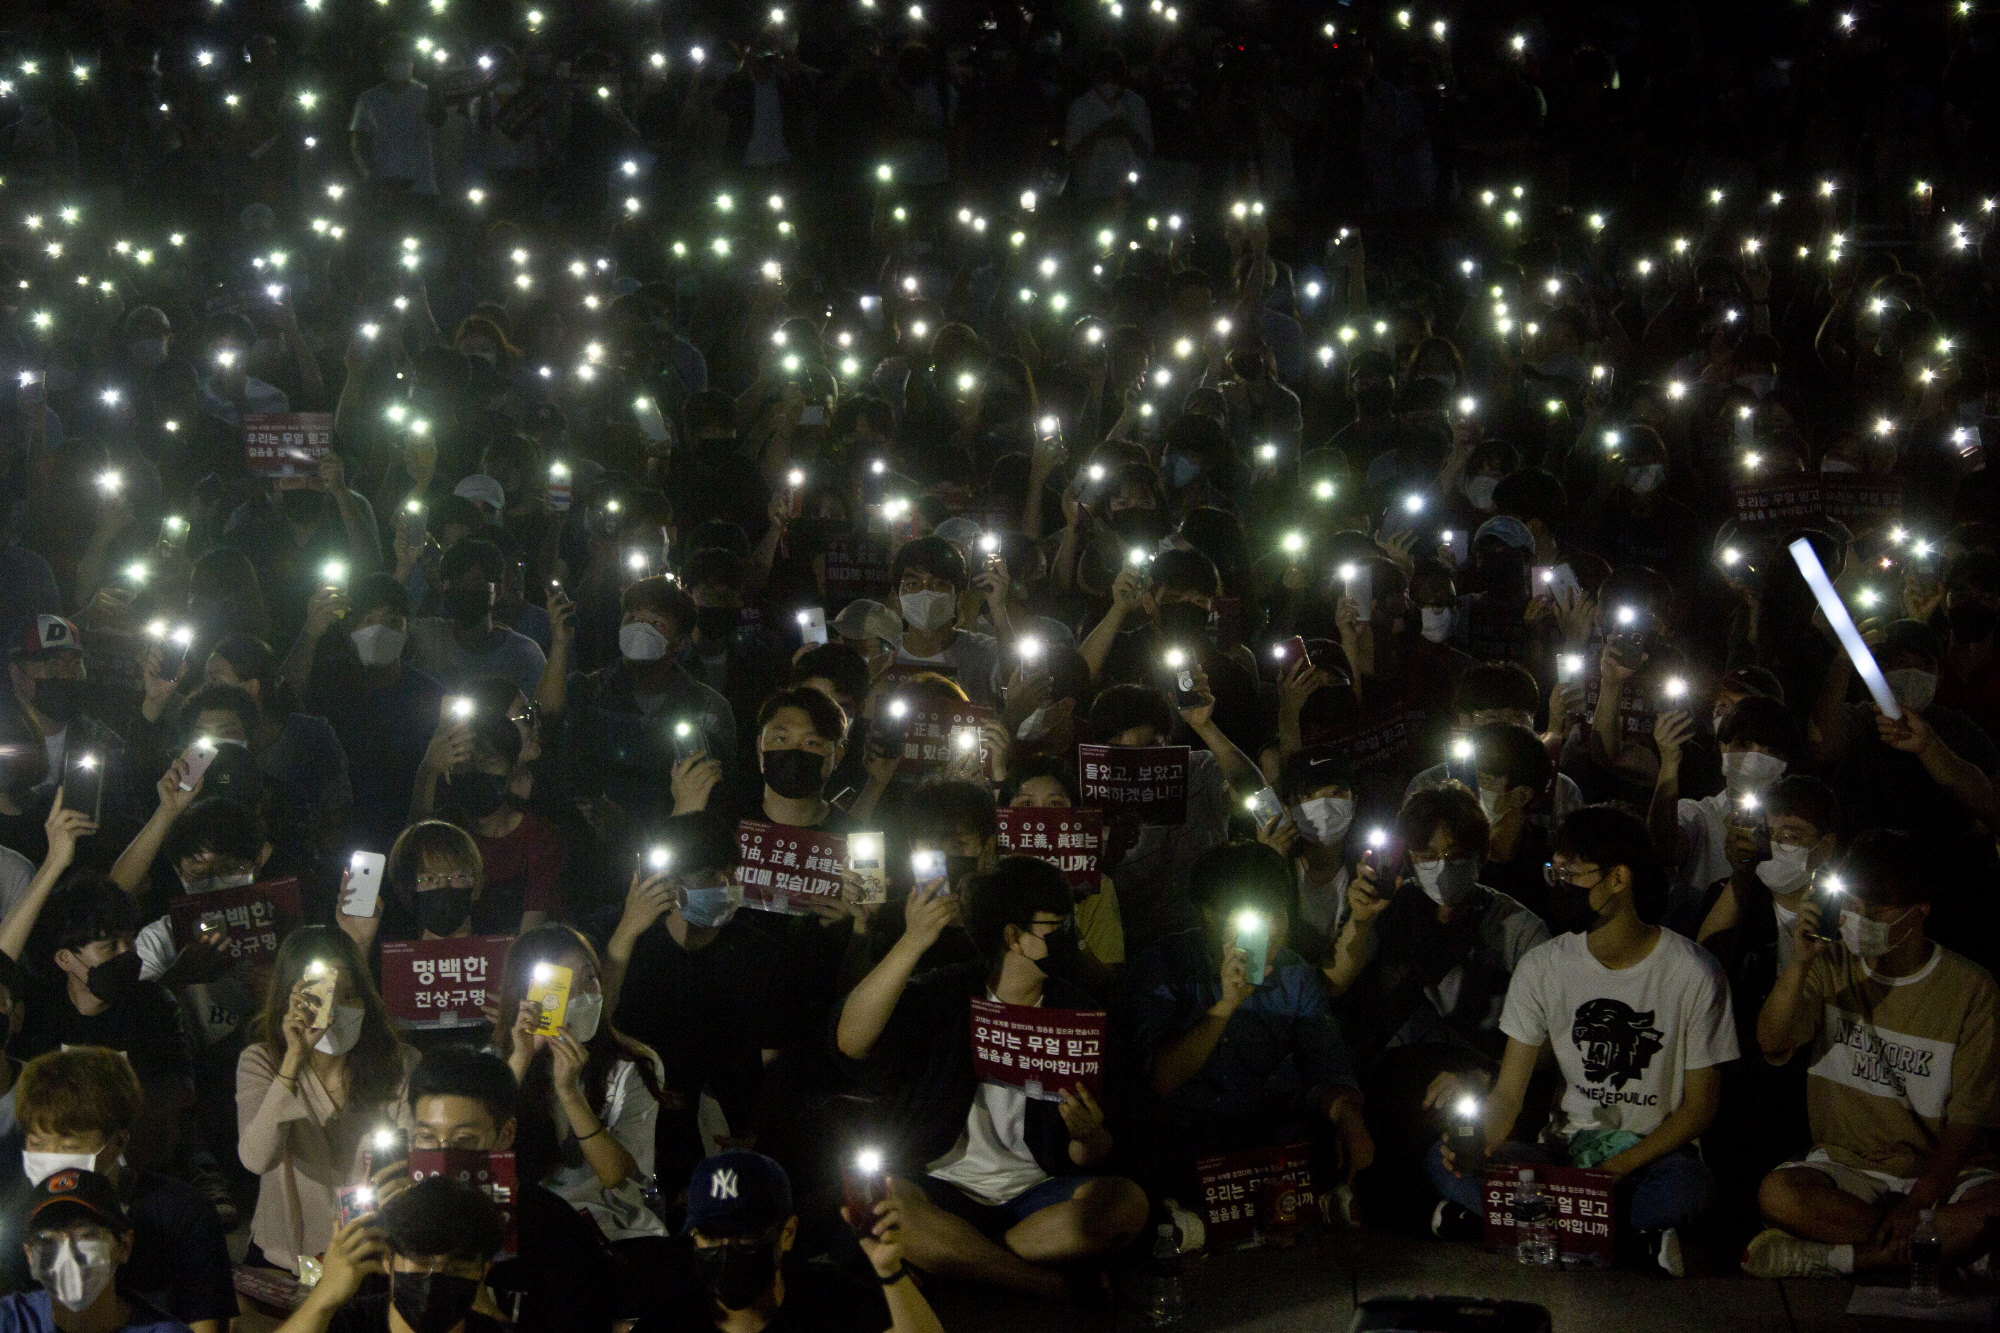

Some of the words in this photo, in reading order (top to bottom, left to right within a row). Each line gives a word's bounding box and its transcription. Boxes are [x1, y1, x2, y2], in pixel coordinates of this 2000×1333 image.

[247, 432, 279, 445] 우리는
[282, 432, 304, 445] 무얼
[308, 432, 330, 445] 믿고
[46, 623, 67, 642] D
[1085, 763, 1132, 782] 들었고,
[1138, 764, 1184, 781] 보았고
[1085, 784, 1183, 802] 기억하겠습니다
[1020, 833, 1053, 851] 正義,
[768, 849, 800, 870] 正義,
[775, 872, 841, 897] 있습니까?
[229, 932, 277, 958] 상규명
[412, 955, 489, 985] 명백한
[414, 988, 487, 1009] 진상규명
[975, 1026, 1022, 1050] 우리는
[1027, 1035, 1060, 1056] 무얼
[1066, 1039, 1100, 1057] 믿고
[977, 1046, 1013, 1067] 젊음을
[1017, 1054, 1099, 1076] 걸어야합니까
[1205, 1183, 1245, 1204] 우리는
[1487, 1190, 1515, 1208] 우리
[1578, 1199, 1609, 1218] 믿고
[1208, 1204, 1241, 1224] 젊음을
